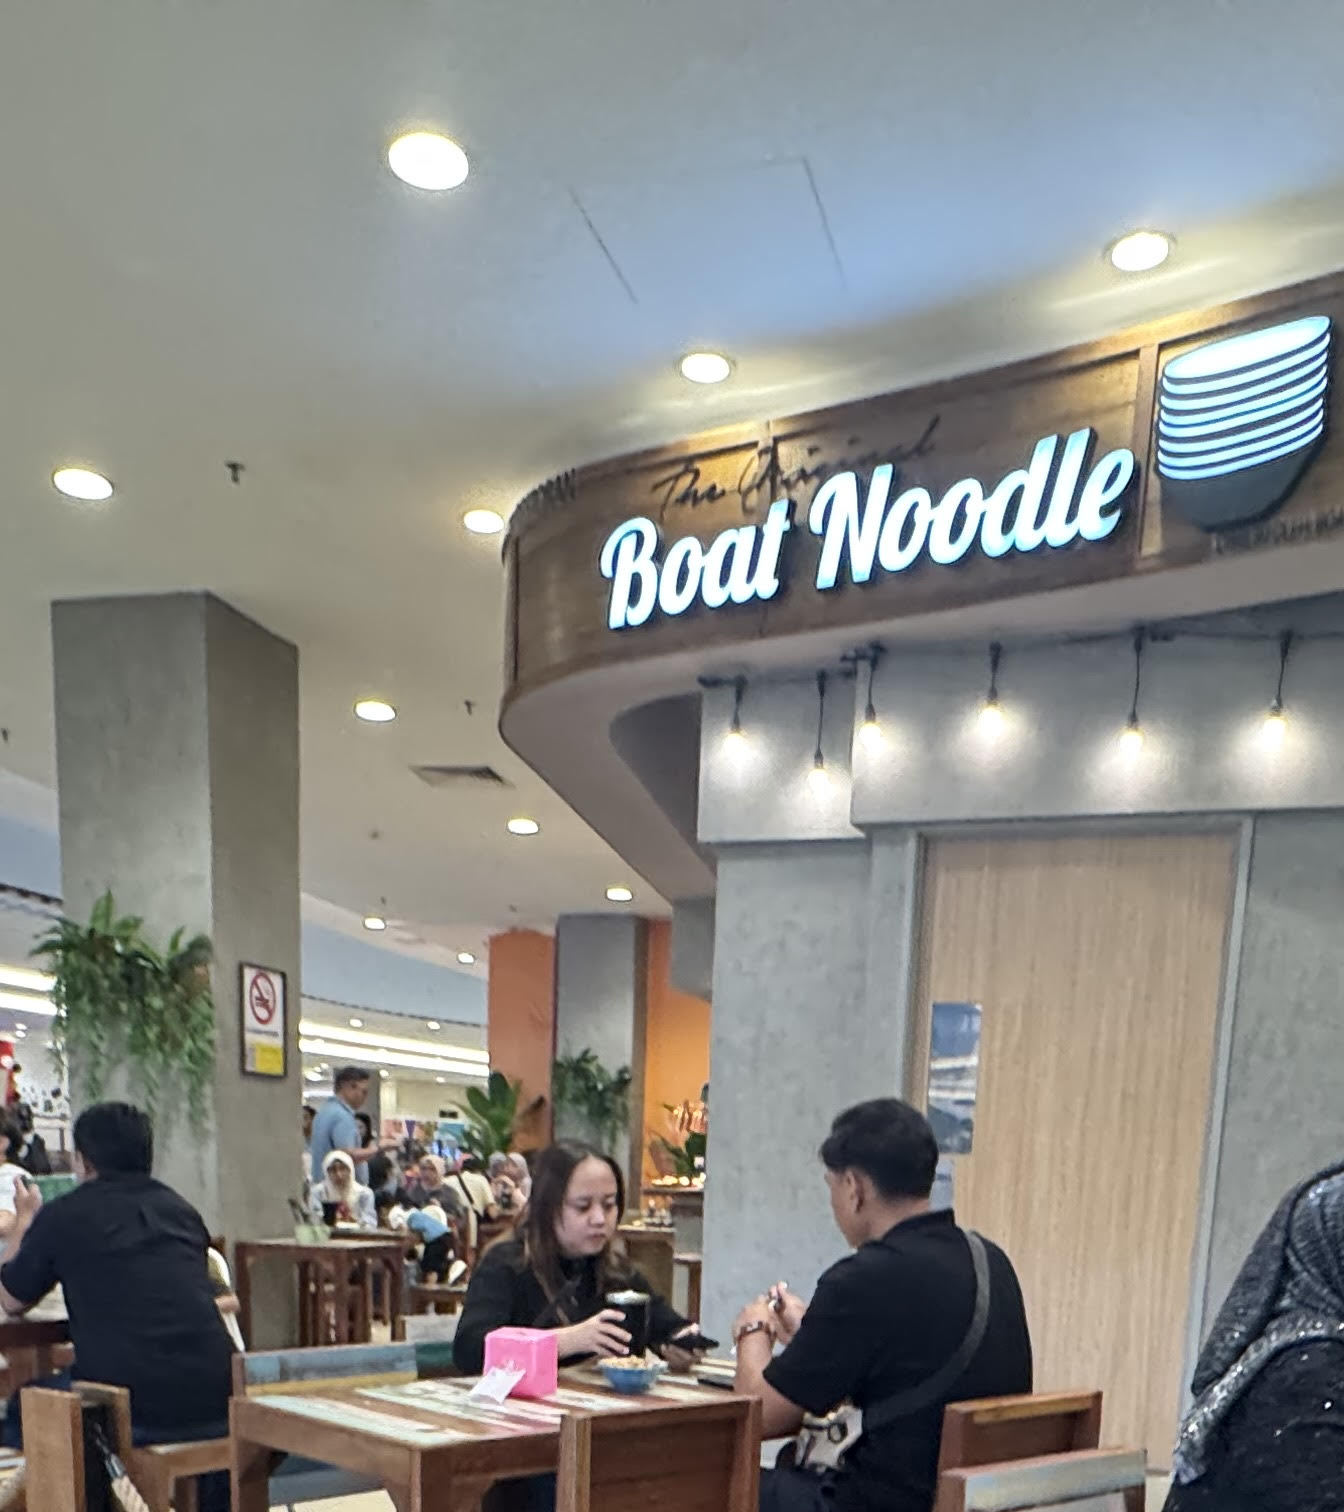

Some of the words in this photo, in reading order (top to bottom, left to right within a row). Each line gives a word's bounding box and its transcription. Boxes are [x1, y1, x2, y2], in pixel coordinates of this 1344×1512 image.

[601, 516, 791, 631] Boat
[808, 427, 1135, 591] Noodle
[652, 462, 726, 518] The
